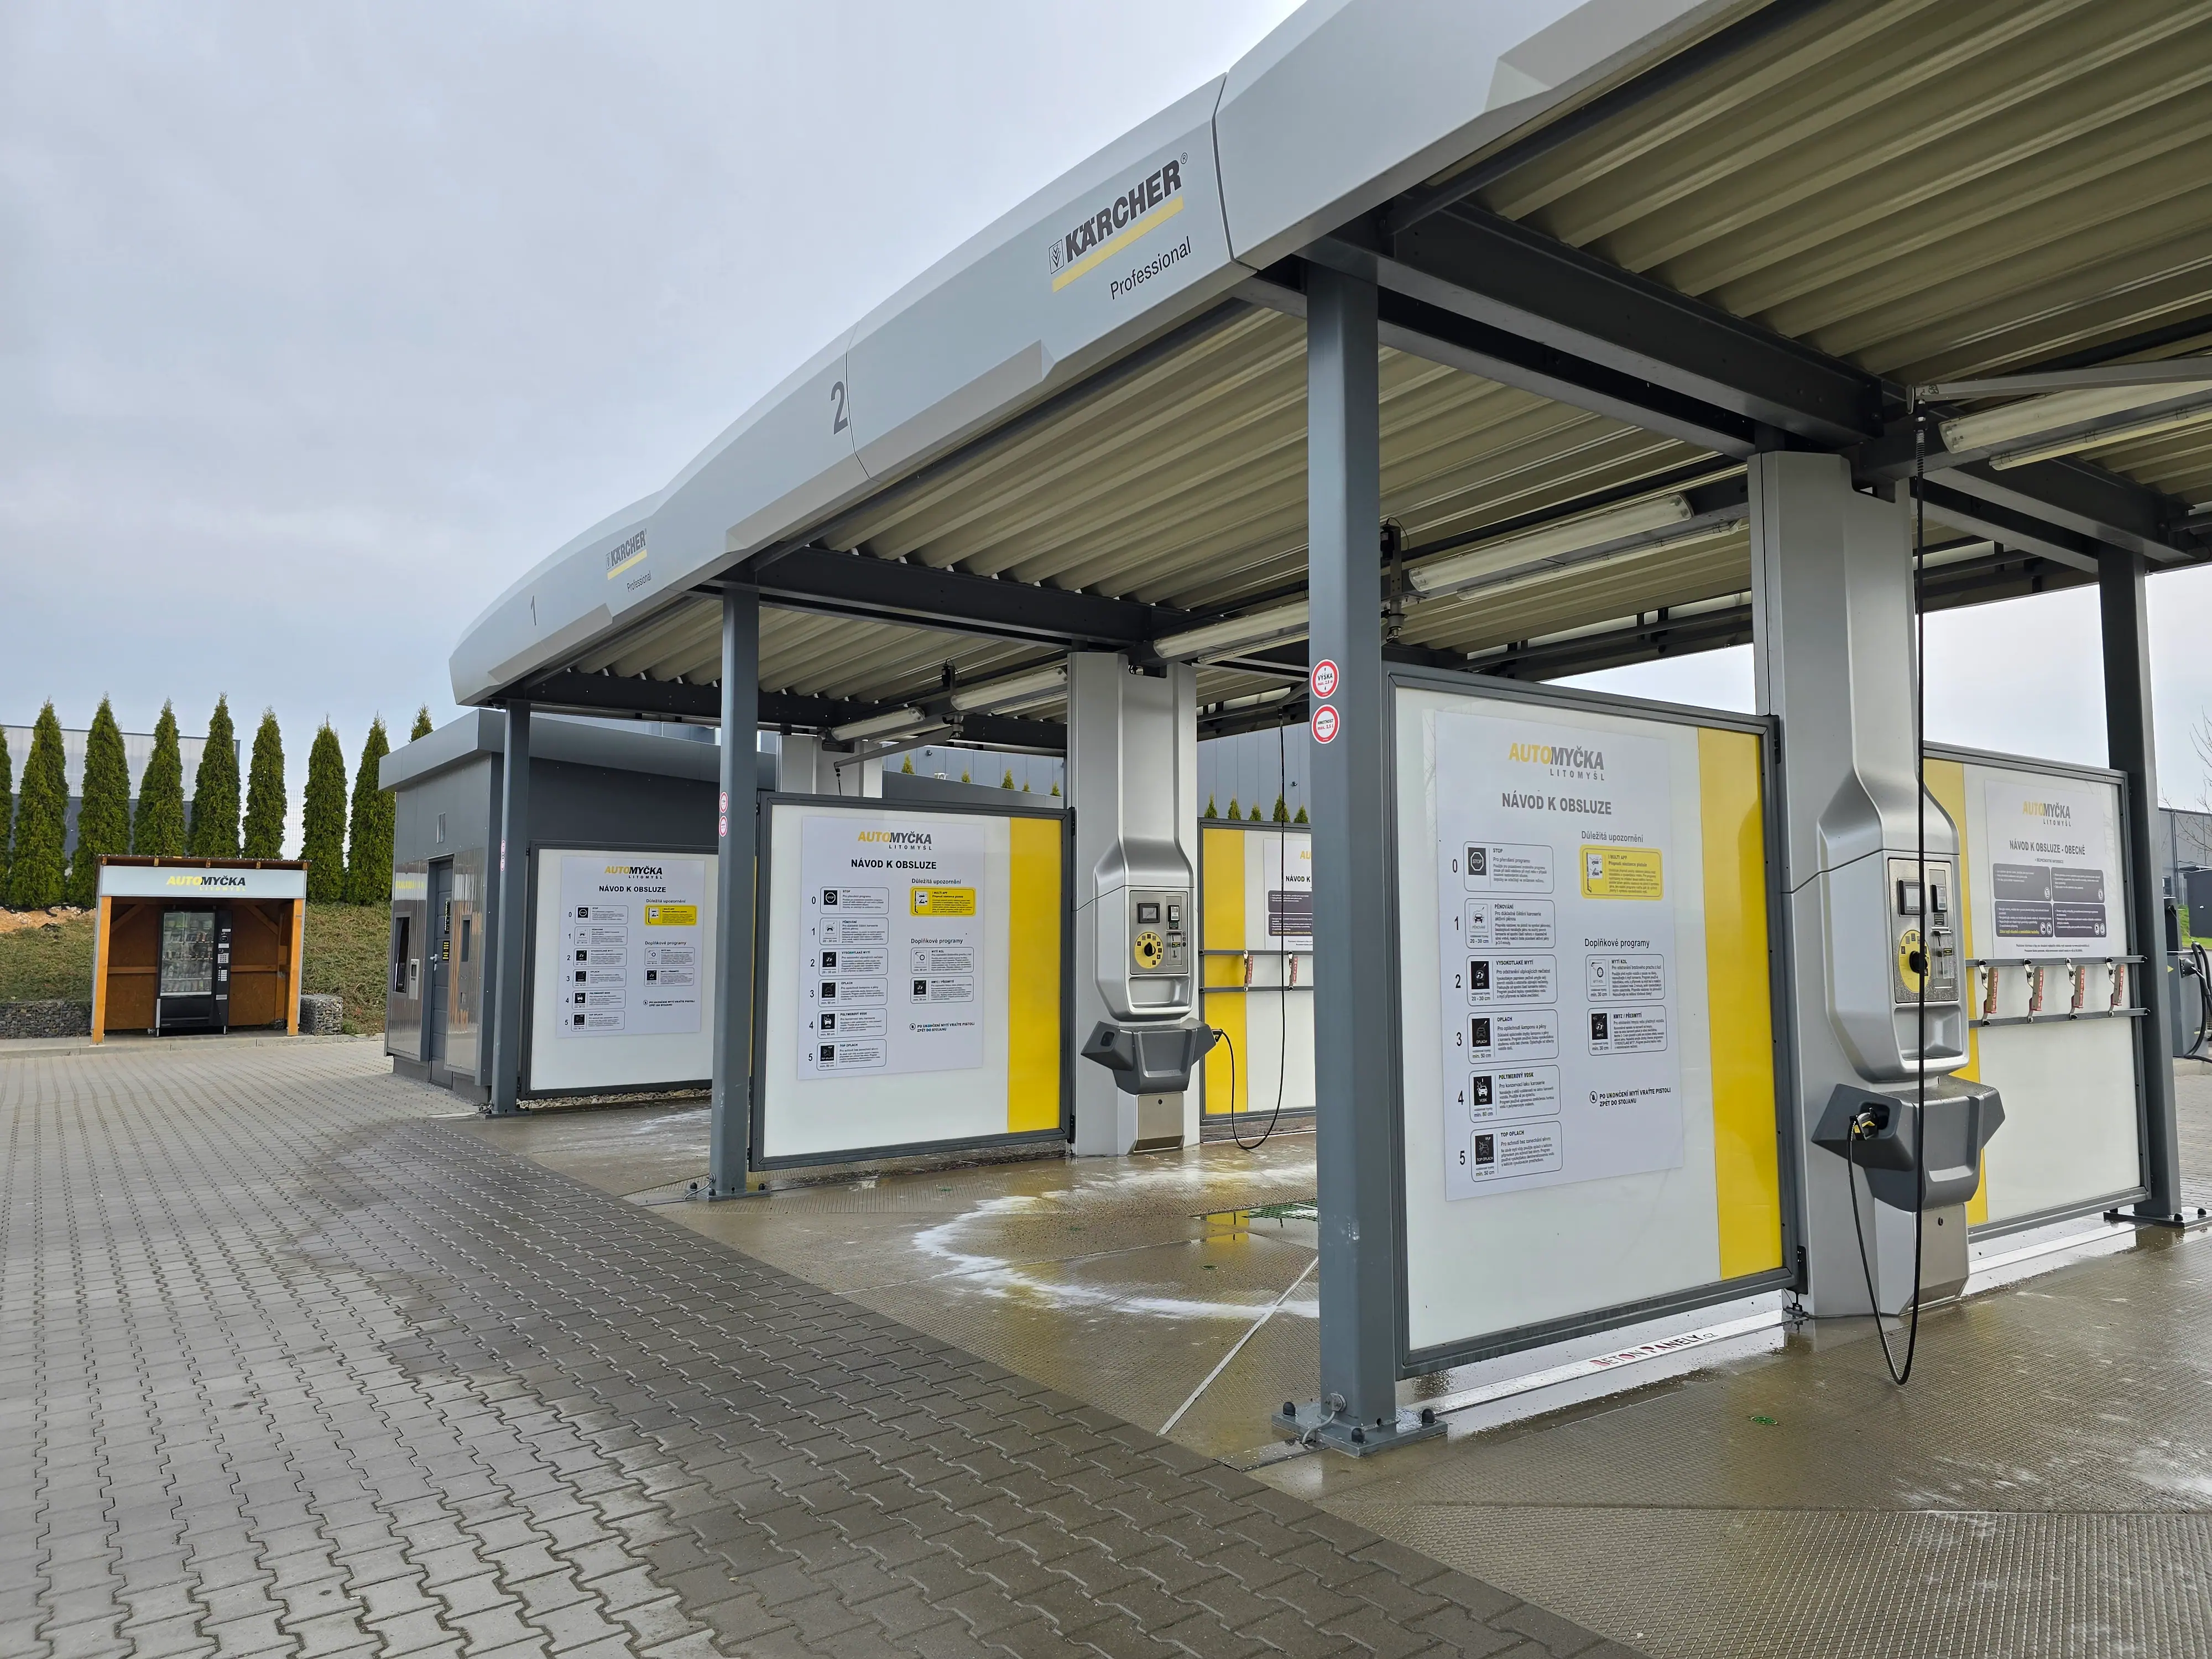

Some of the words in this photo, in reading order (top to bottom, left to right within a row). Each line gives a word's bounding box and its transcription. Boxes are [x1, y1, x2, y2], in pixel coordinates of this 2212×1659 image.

[1110, 236, 1191, 300] Professional
[831, 382, 848, 435] 2
[627, 571, 651, 592] Professional
[530, 595, 536, 626] 1
[1318, 672, 1333, 681] VÝŠKA
[1508, 743, 1604, 770] AUTOMYČKA
[1550, 768, 1604, 780] LITOMYŠL
[1503, 790, 1544, 809] NÁVOD
[1548, 797, 1556, 810] K
[1560, 798, 1611, 815] OBSLUZE
[2023, 801, 2070, 819] AUTOMYČKA
[2043, 818, 2071, 827] LITOMYŠL
[858, 831, 932, 844] AUTOMYČKA
[1582, 831, 1606, 840] Důležitá
[2010, 838, 2028, 851] NÁVOD
[2031, 842, 2034, 851] K
[2036, 843, 2060, 853] OBSLUZE
[2065, 844, 2085, 855] OBECNĚ
[851, 858, 883, 868] NÁVOD
[896, 861, 937, 869] OBSLUZE
[1452, 859, 1457, 873] 0
[604, 865, 662, 875] AUTOMYČKA
[166, 875, 246, 886] AUTOMYČKA
[811, 896, 816, 905] 0
[1454, 916, 1459, 930] 1
[811, 927, 816, 936] 1
[1585, 938, 1618, 948] Doplňkové
[1621, 940, 1650, 948] programy
[810, 958, 815, 967] 2
[1455, 974, 1461, 989] 2
[810, 989, 814, 998] 3
[809, 1021, 813, 1029] 4
[1457, 1032, 1462, 1046] 3
[808, 1053, 813, 1062] 5
[1458, 1091, 1464, 1105] 4
[1606, 1090, 1628, 1098] UKONČENÍ
[1459, 1150, 1465, 1165] 5
